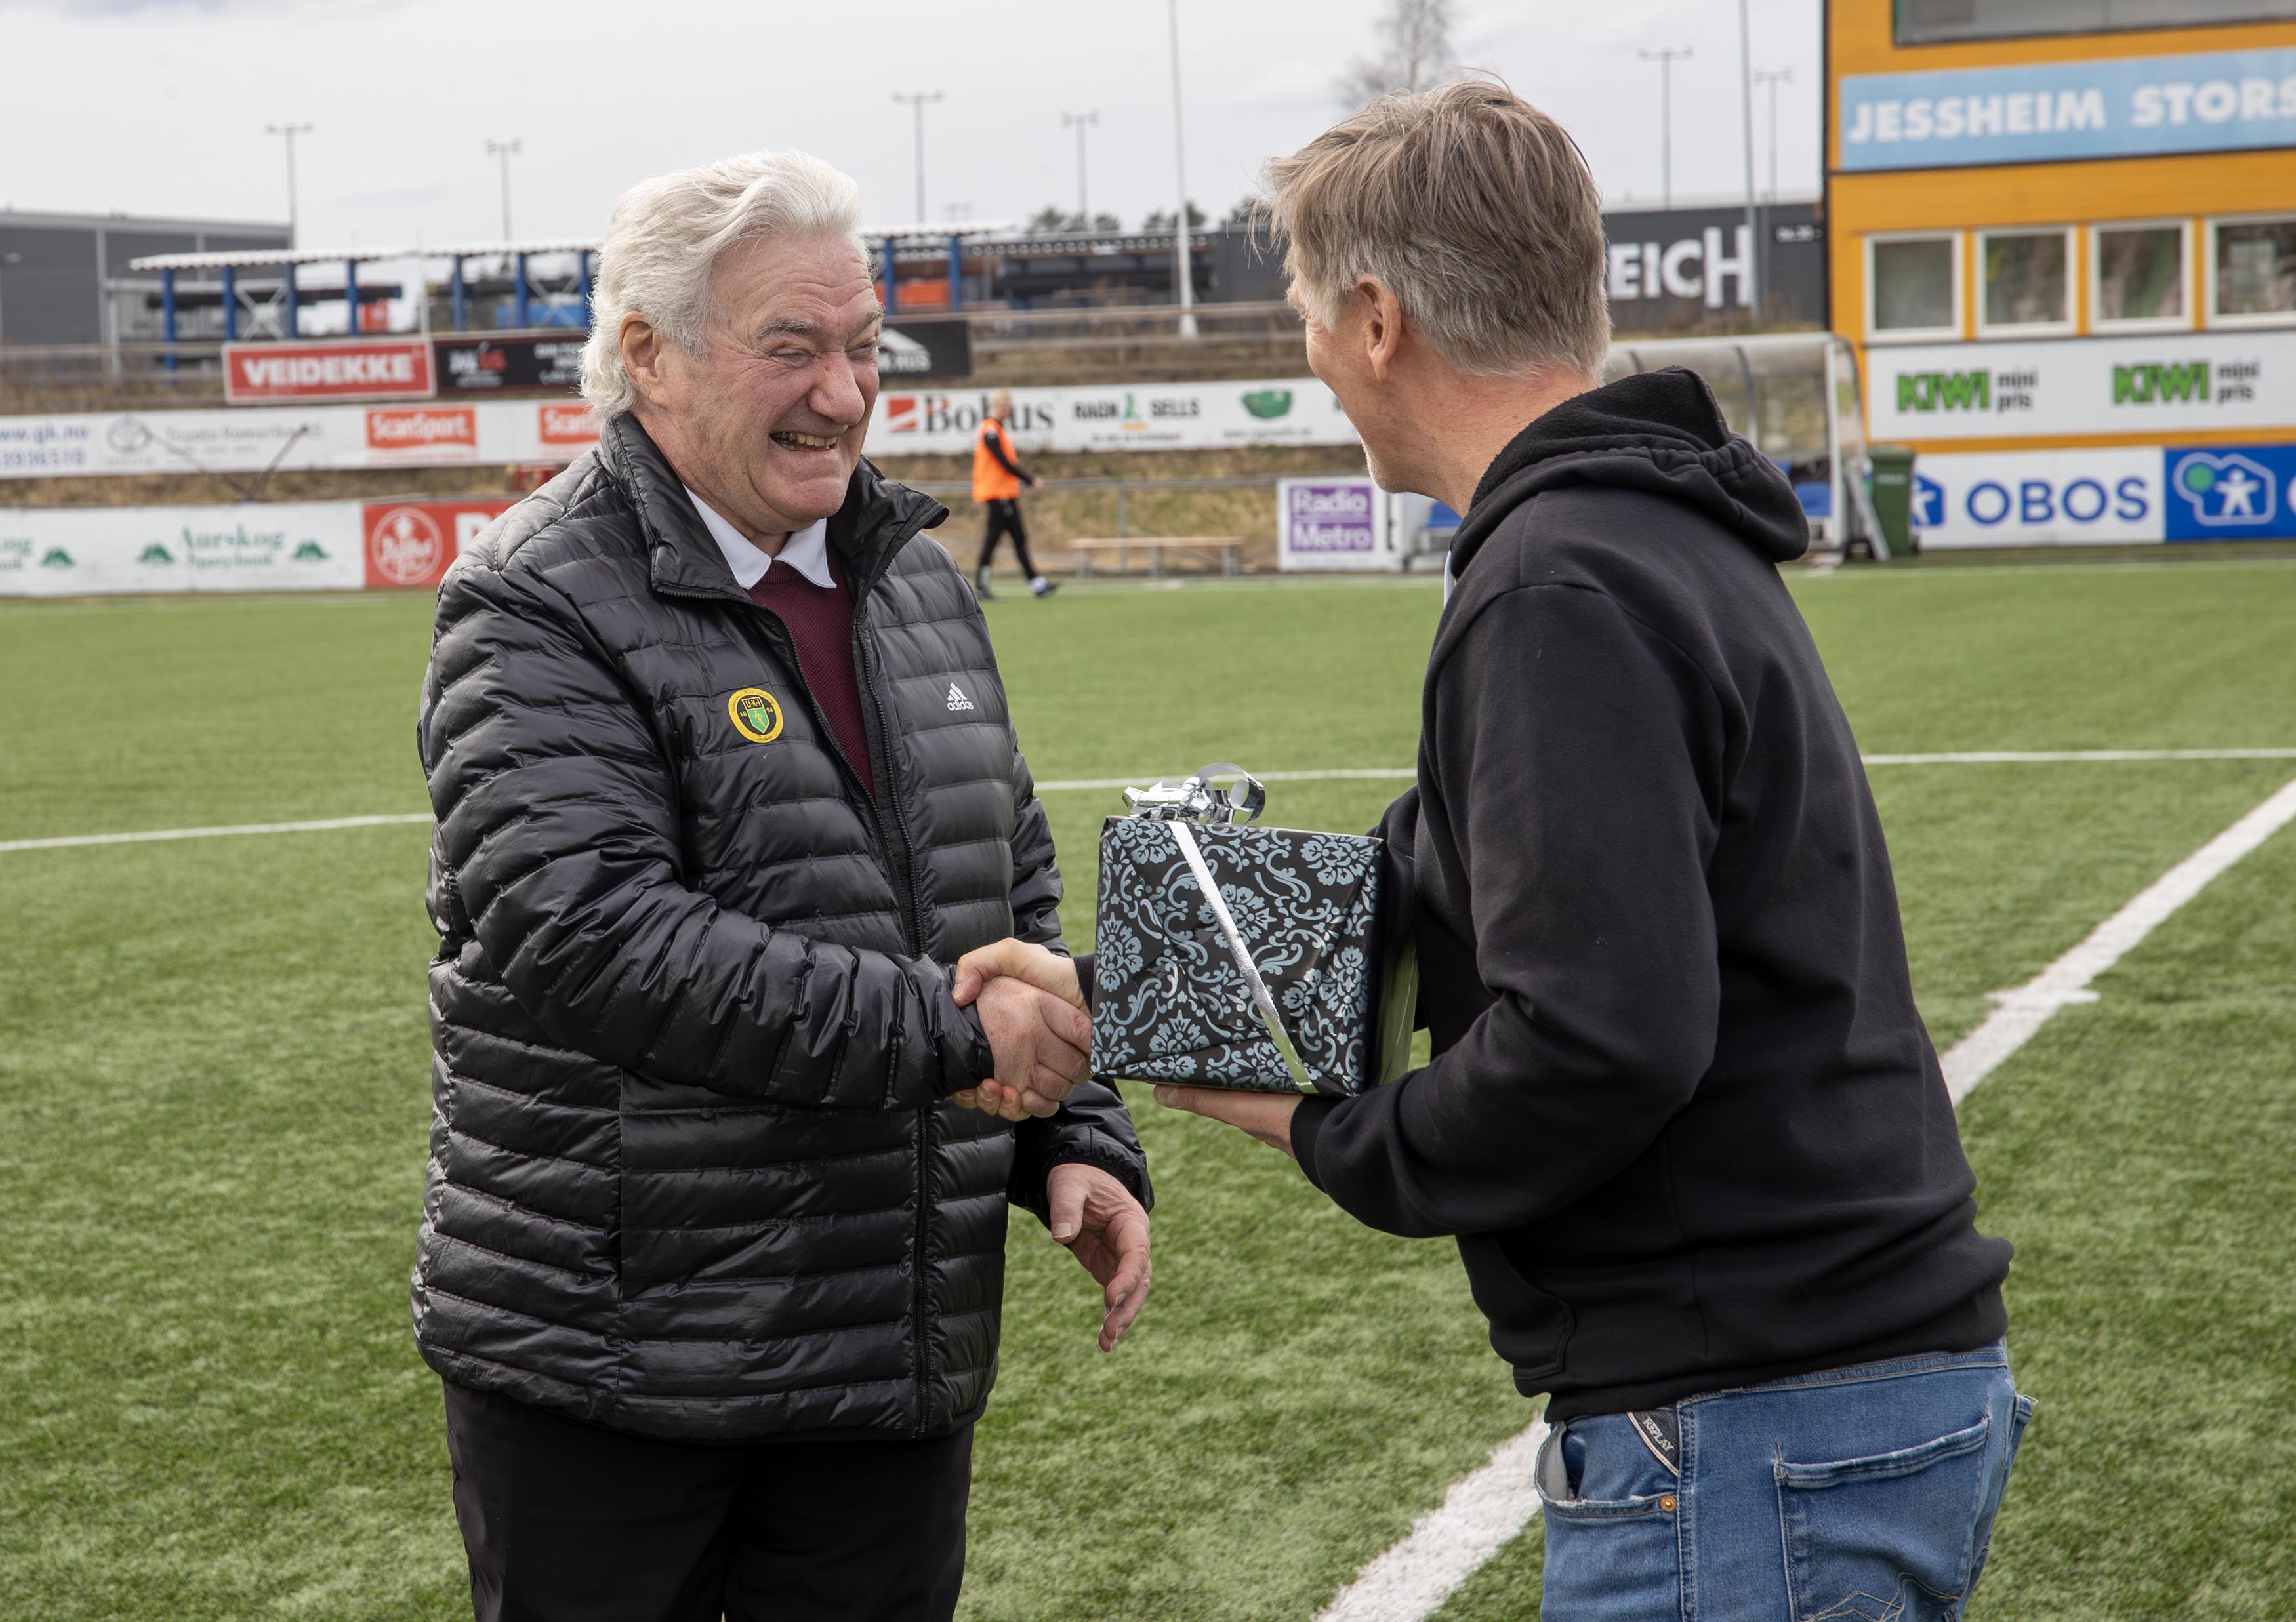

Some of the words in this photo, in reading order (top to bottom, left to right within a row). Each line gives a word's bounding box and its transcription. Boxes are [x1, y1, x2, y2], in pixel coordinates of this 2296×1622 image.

[1847, 88, 2106, 144] JESSHEIM
[243, 354, 414, 386] VEIDEKKE
[1997, 369, 2036, 388] mini
[2112, 361, 2209, 404] KIWI
[2217, 359, 2259, 380] mini
[1896, 372, 1989, 412] KIWI
[1997, 393, 2032, 413] pris
[2217, 383, 2254, 404] pris
[1292, 487, 1369, 515] Radio
[1967, 477, 2148, 525] OBOS
[1292, 523, 1372, 549] Metro
[947, 699, 974, 710] adidas
[1643, 1416, 1674, 1452] REPLAY
